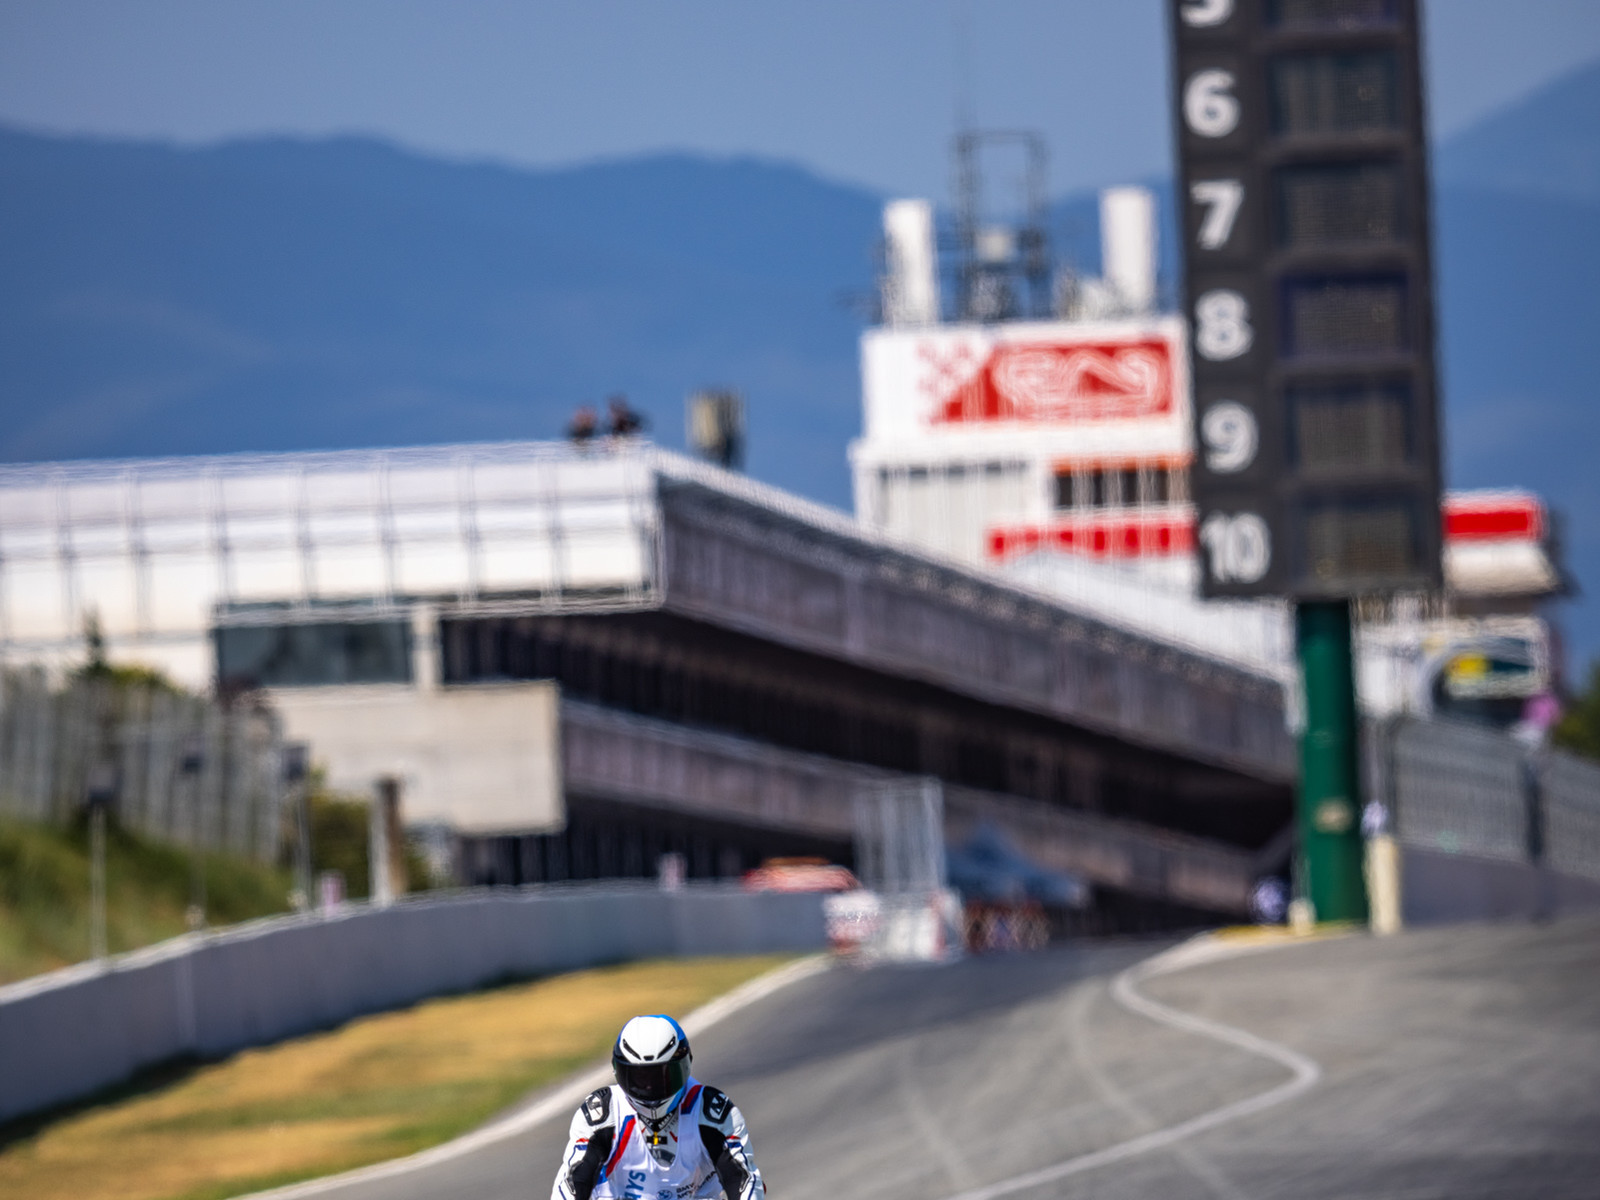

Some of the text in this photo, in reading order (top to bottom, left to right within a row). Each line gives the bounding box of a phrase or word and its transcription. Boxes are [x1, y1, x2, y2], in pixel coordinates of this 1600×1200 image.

[1184, 68, 1239, 138] 6
[1191, 179, 1243, 249] 7
[1195, 290, 1252, 361] 8
[1202, 401, 1258, 473] 9
[1200, 512, 1270, 585] 10
